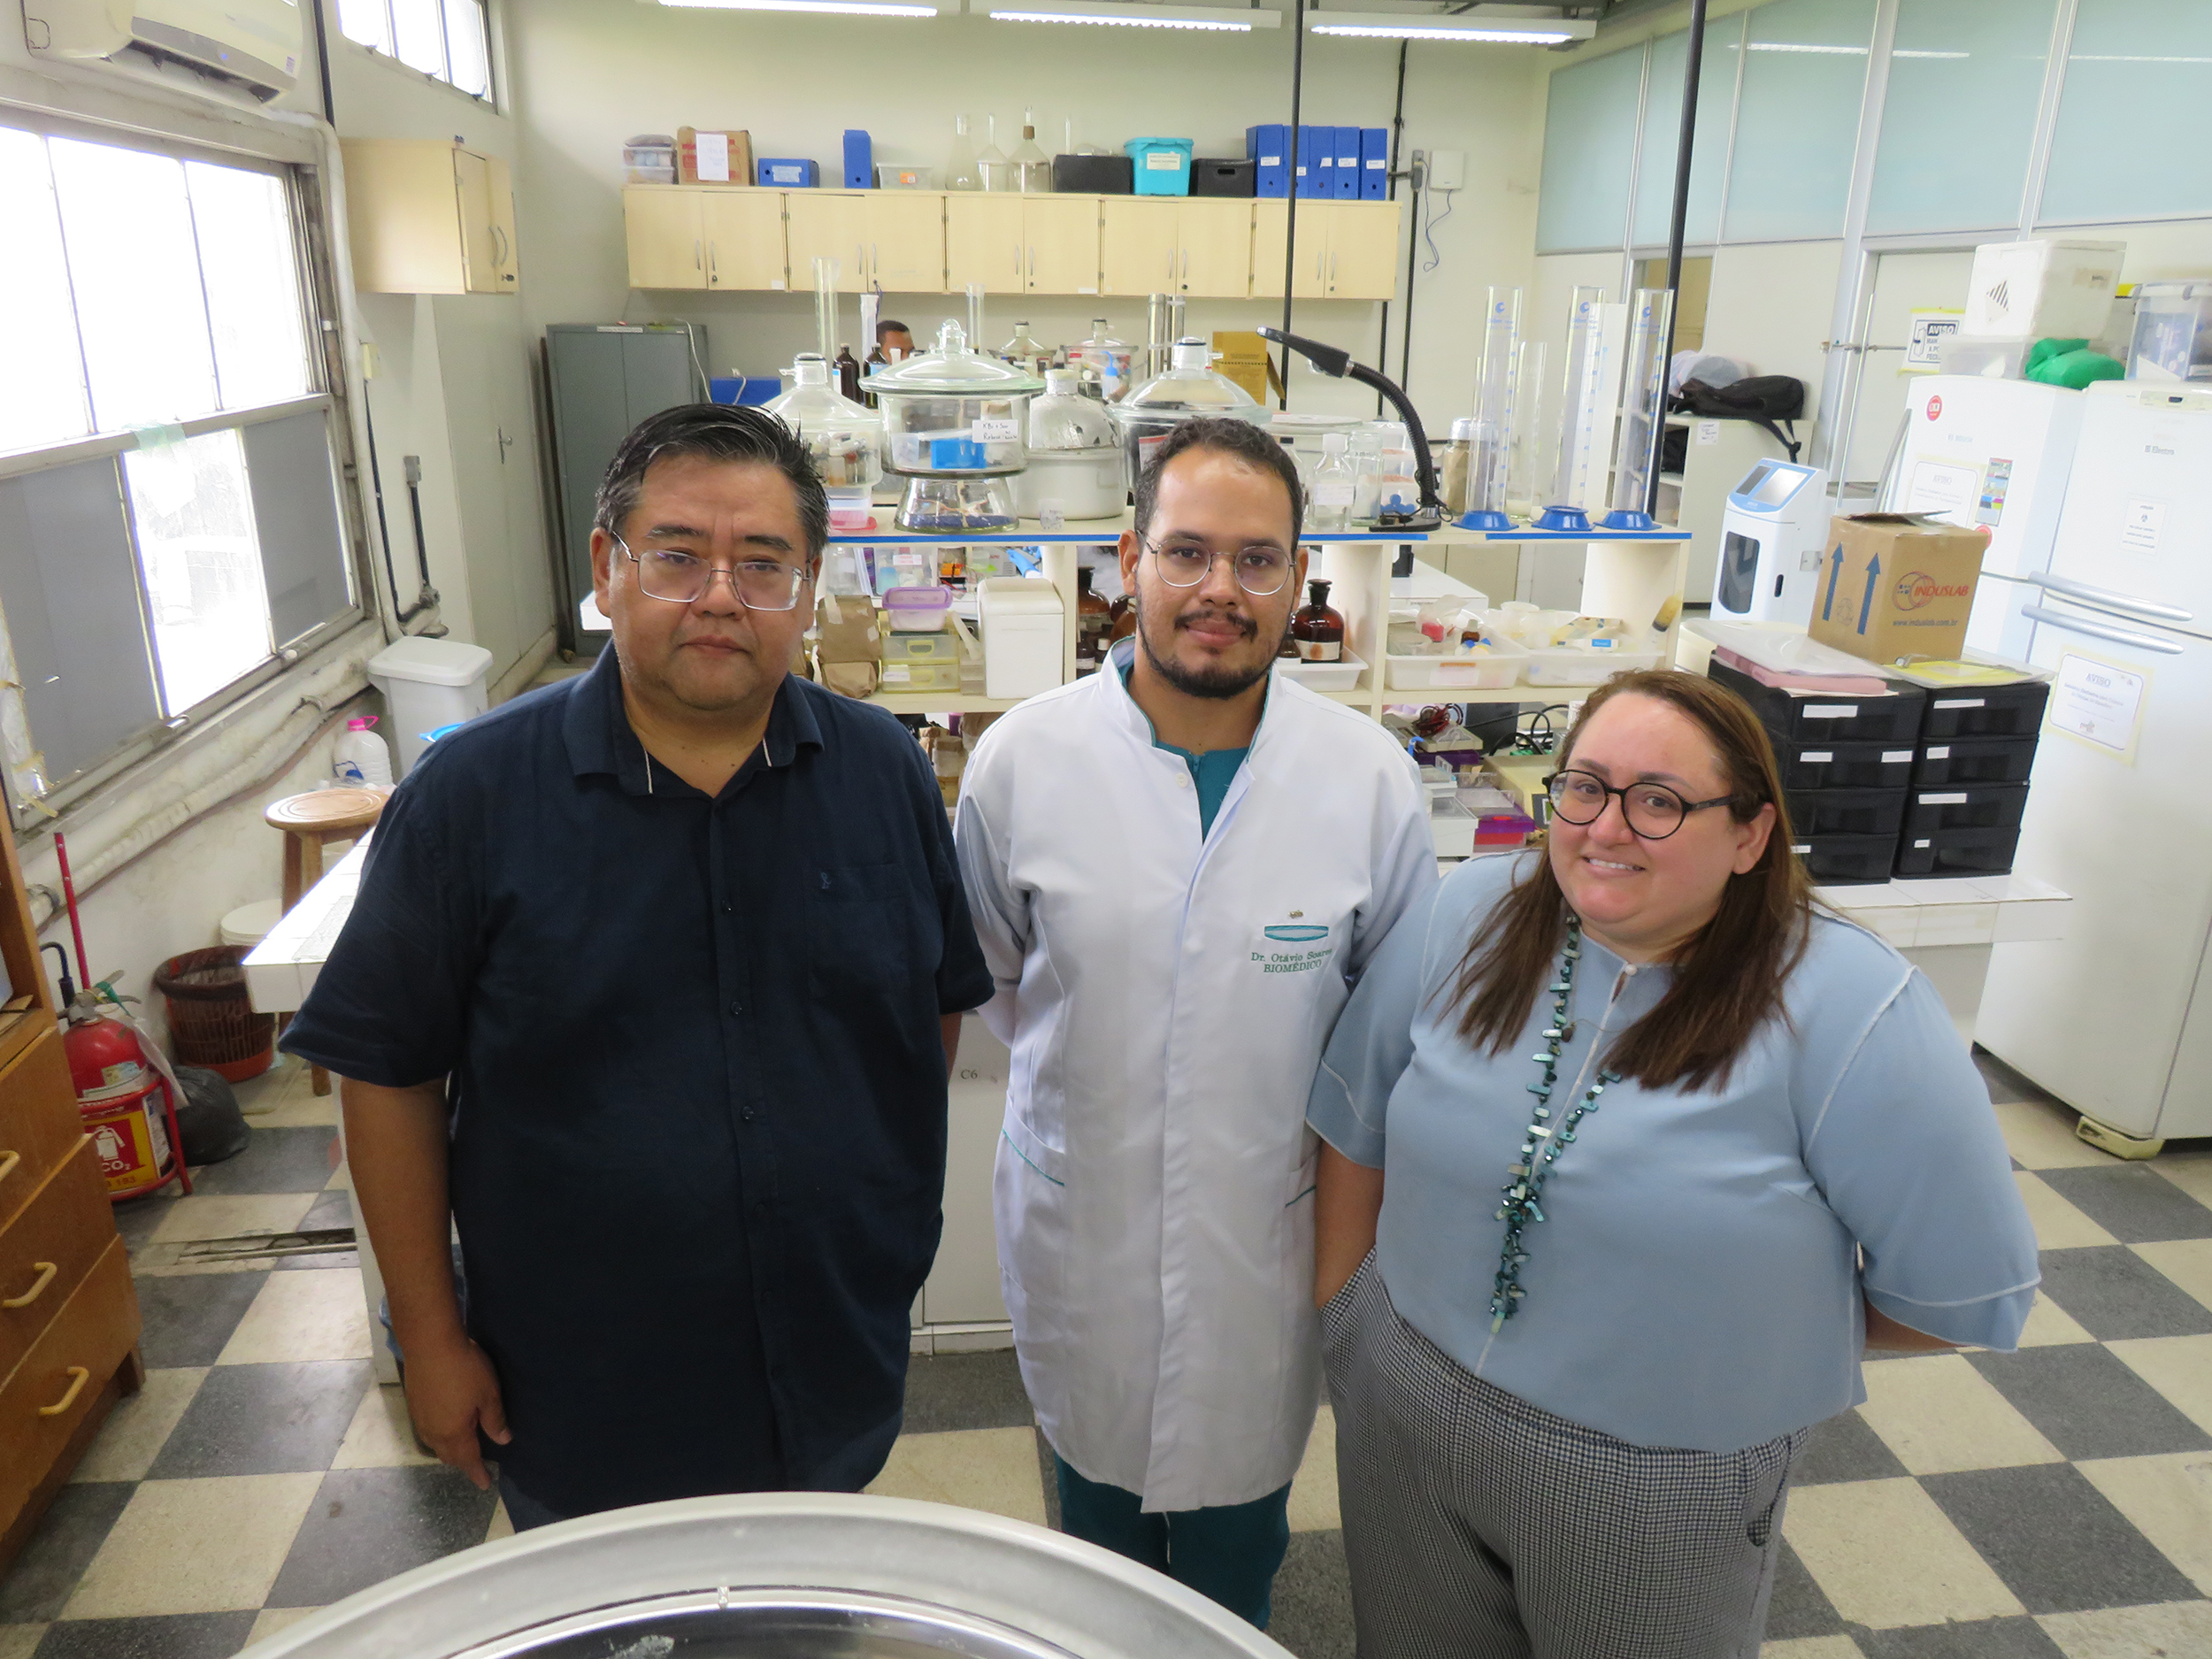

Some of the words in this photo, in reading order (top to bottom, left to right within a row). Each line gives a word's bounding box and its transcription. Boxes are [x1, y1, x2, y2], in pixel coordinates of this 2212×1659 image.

[1929, 326, 1955, 334] AVISO
[1914, 586, 1969, 596] INDUSLAB
[2085, 672, 2112, 687] AVISO
[1251, 952, 1265, 962] Dr.
[1271, 953, 1303, 963] Otávio
[1307, 948, 1333, 960] Soares
[1263, 959, 1322, 973] BIOMÉDICO
[960, 1069, 978, 1079] C6
